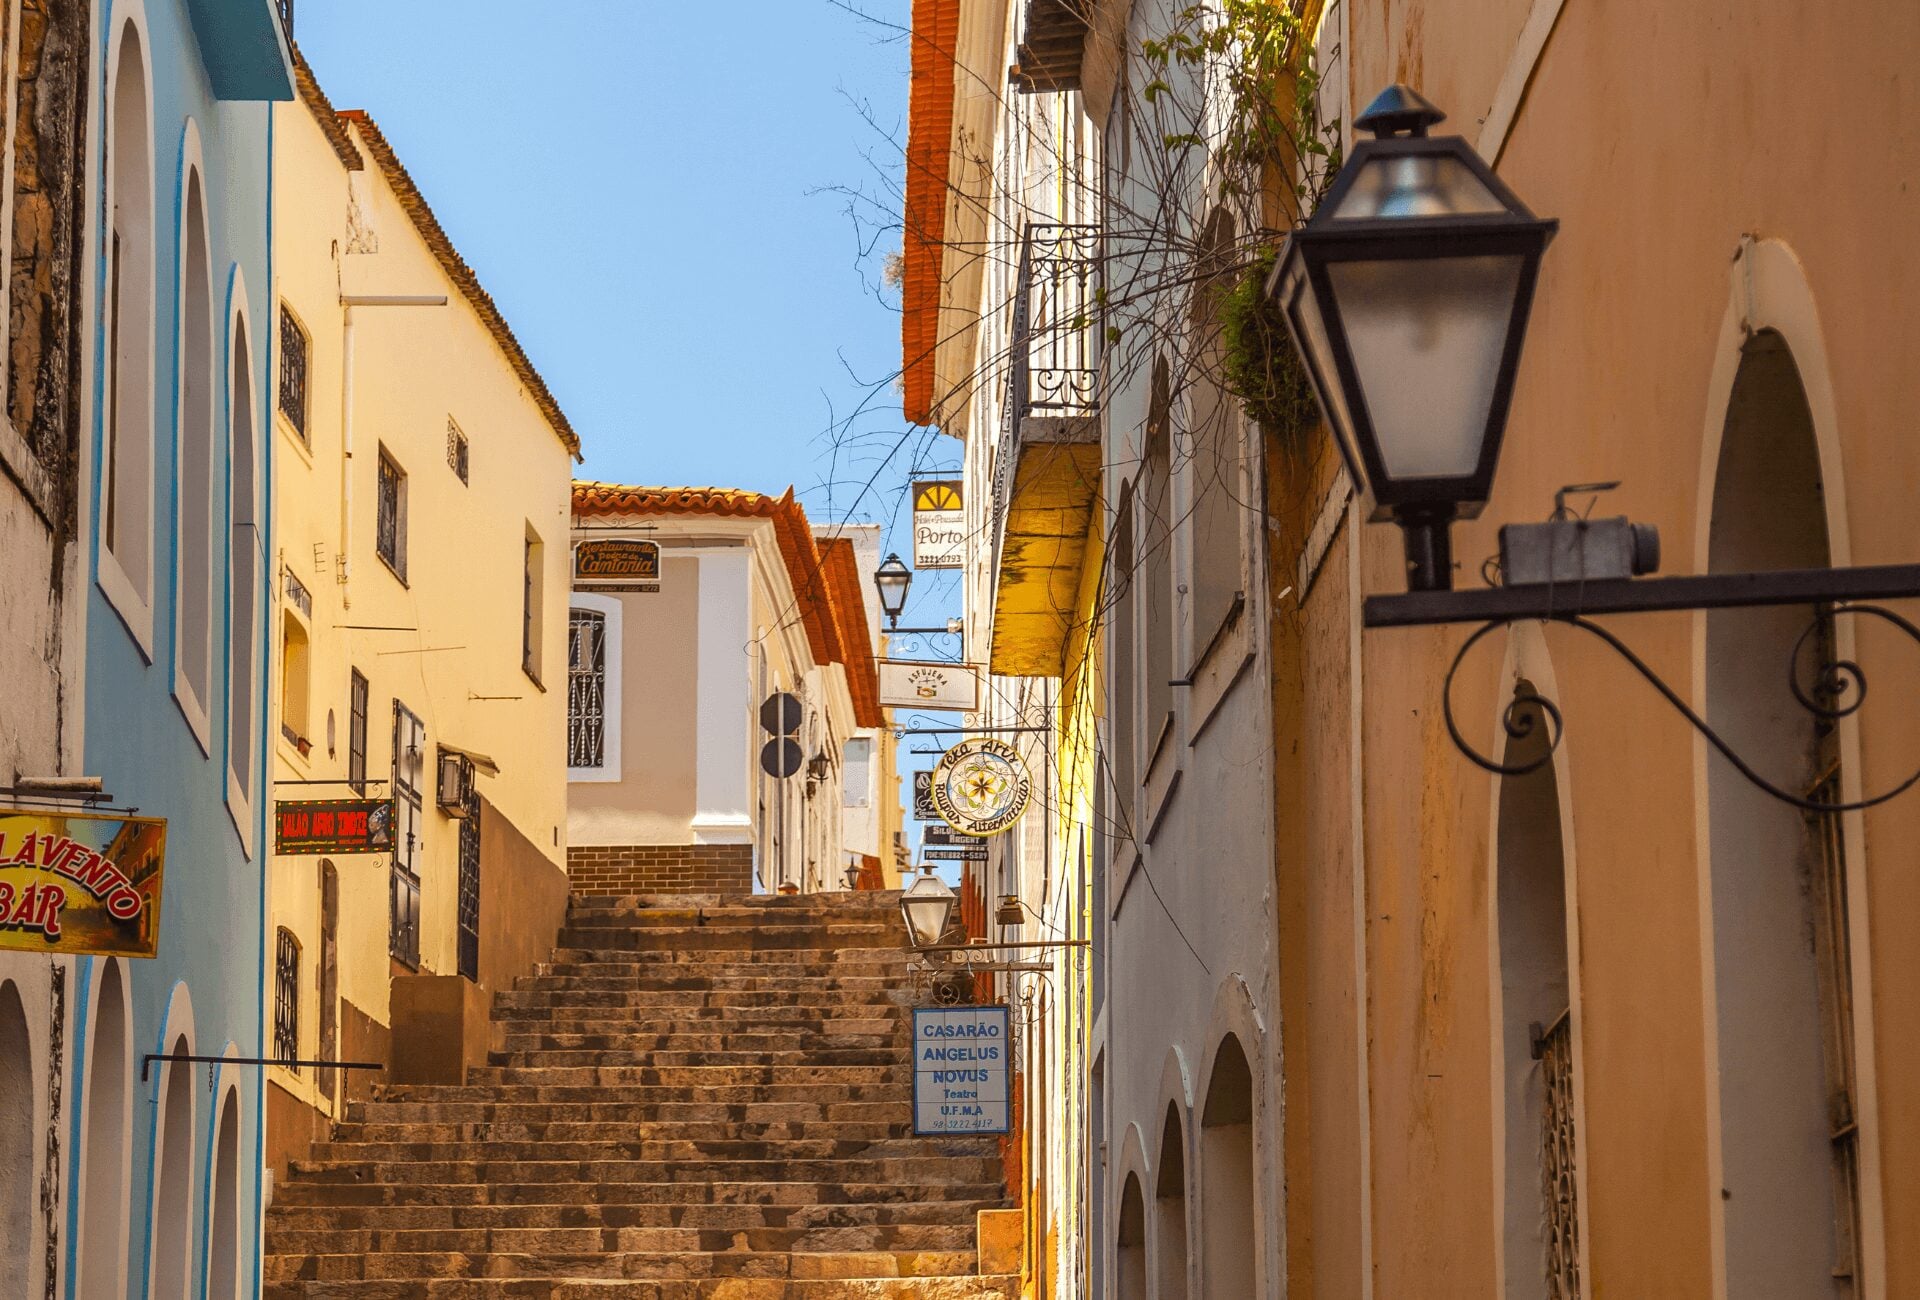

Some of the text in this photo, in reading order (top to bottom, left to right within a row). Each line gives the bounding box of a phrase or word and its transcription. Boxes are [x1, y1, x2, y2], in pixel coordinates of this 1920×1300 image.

[917, 526, 963, 545] Porto
[581, 541, 656, 555] Restaurante
[580, 554, 653, 573] Cantaria
[908, 668, 948, 685] ASFUJEMA
[980, 740, 1019, 763] Arts
[0, 878, 66, 935] BAR
[923, 1022, 999, 1037] CASARÃO
[923, 1047, 999, 1061] ANGELUS
[933, 1068, 989, 1084] NOVUS
[943, 1088, 977, 1099] Teatro
